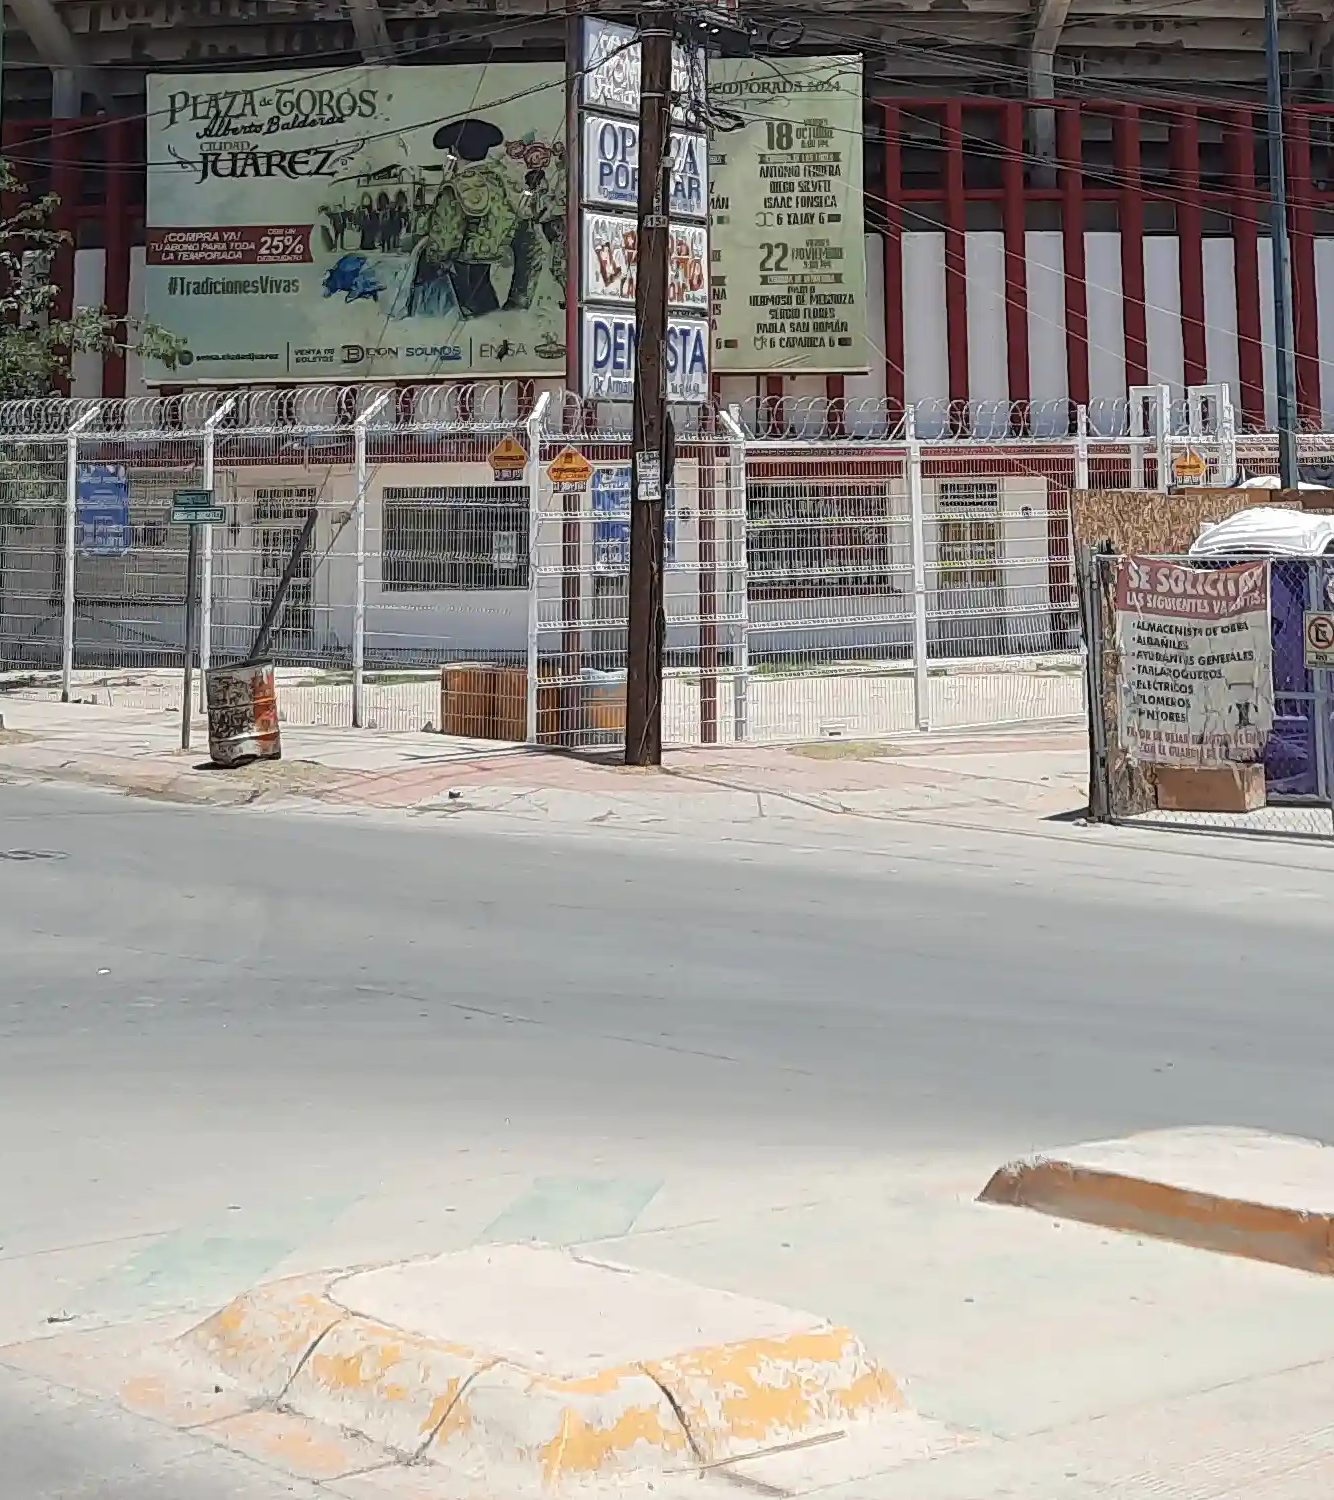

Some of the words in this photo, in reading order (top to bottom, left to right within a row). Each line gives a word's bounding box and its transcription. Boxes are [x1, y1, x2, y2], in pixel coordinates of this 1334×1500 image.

[161, 90, 258, 131] PLAZA
[275, 88, 378, 118] TOROS
[196, 110, 263, 139] Alberto
[262, 114, 346, 136] Balderas
[766, 121, 794, 150] 18
[200, 141, 251, 151] CIUDAD
[195, 144, 339, 184] JUÁREZ
[764, 197, 793, 209] ISAAC
[796, 195, 838, 209] FONSECA
[161, 252, 174, 261] LA
[177, 251, 243, 261] TEMPORADA
[258, 235, 304, 255] 25%
[759, 242, 789, 271] 22
[168, 275, 300, 296] #TradicionesVivas
[1127, 562, 1152, 590] SE
